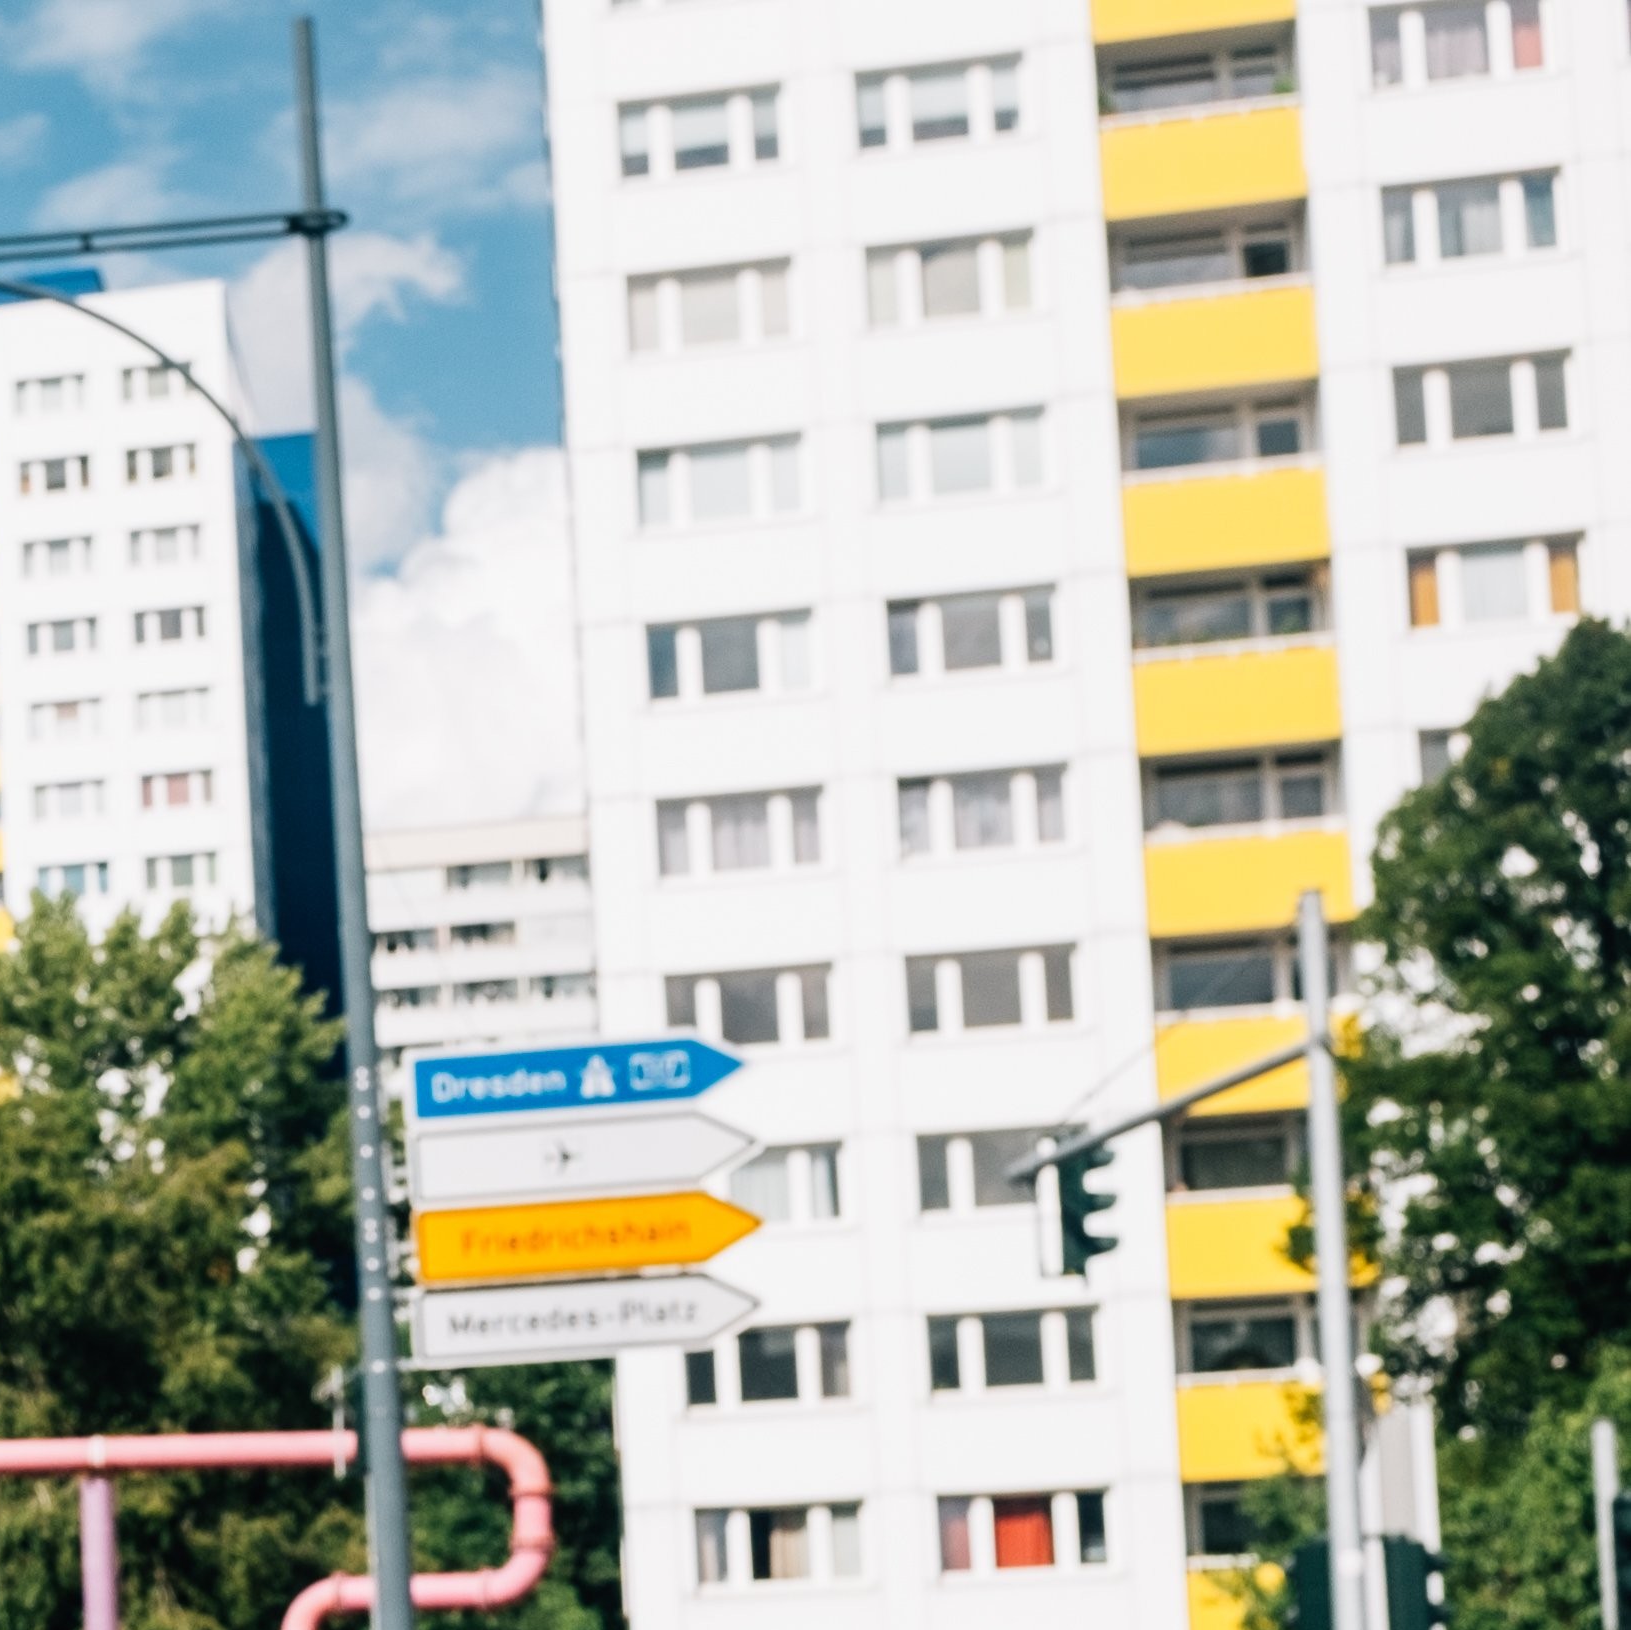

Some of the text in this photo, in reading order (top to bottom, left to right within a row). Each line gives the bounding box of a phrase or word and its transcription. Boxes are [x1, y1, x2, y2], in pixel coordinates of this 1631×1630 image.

[431, 1067, 568, 1103] Dresden
[460, 1219, 693, 1257] Friedrichshain
[448, 1298, 699, 1337] Mercedes-Platz
